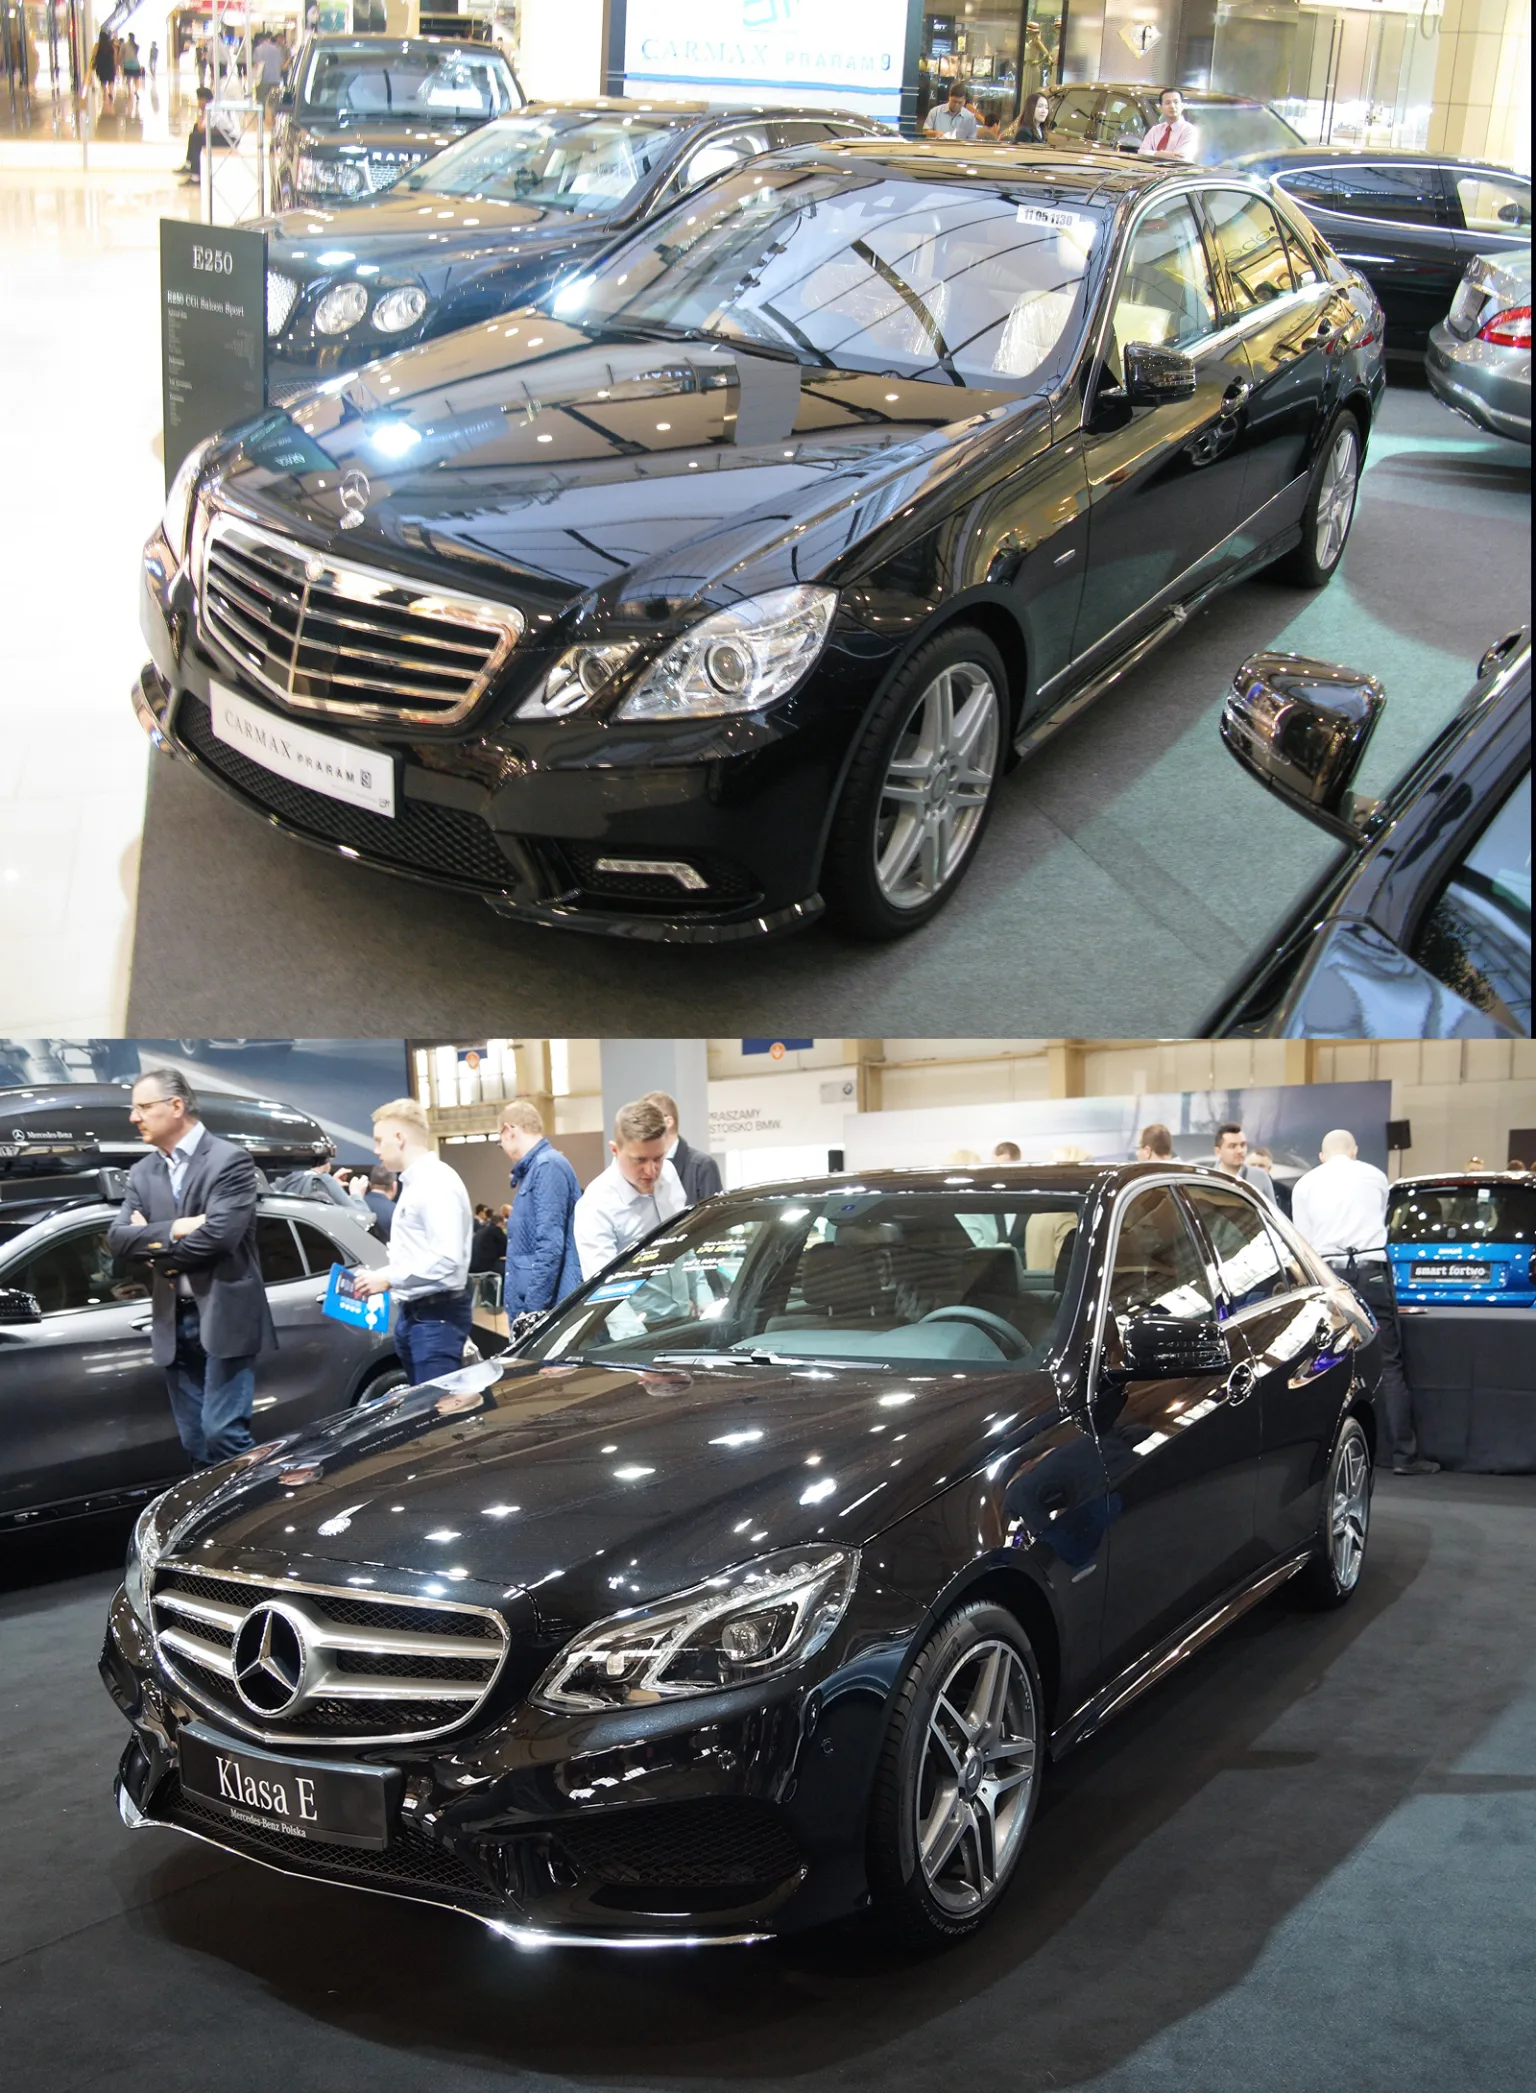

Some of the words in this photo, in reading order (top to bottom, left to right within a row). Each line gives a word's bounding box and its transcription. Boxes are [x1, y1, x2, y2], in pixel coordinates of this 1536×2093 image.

[641, 38, 769, 66] CARMAX
[192, 244, 233, 275] E250
[224, 708, 292, 761] CARMAX
[297, 752, 355, 785] PRARAM
[26, 1131, 73, 1139] Mercedes-Benz
[1415, 1266, 1447, 1276] smart
[1448, 1265, 1486, 1276] fortwo
[216, 1756, 290, 1816] Klasa
[295, 1777, 318, 1821] E
[230, 1808, 280, 1832] Mercedes-Benz
[281, 1822, 307, 1838] Polska
